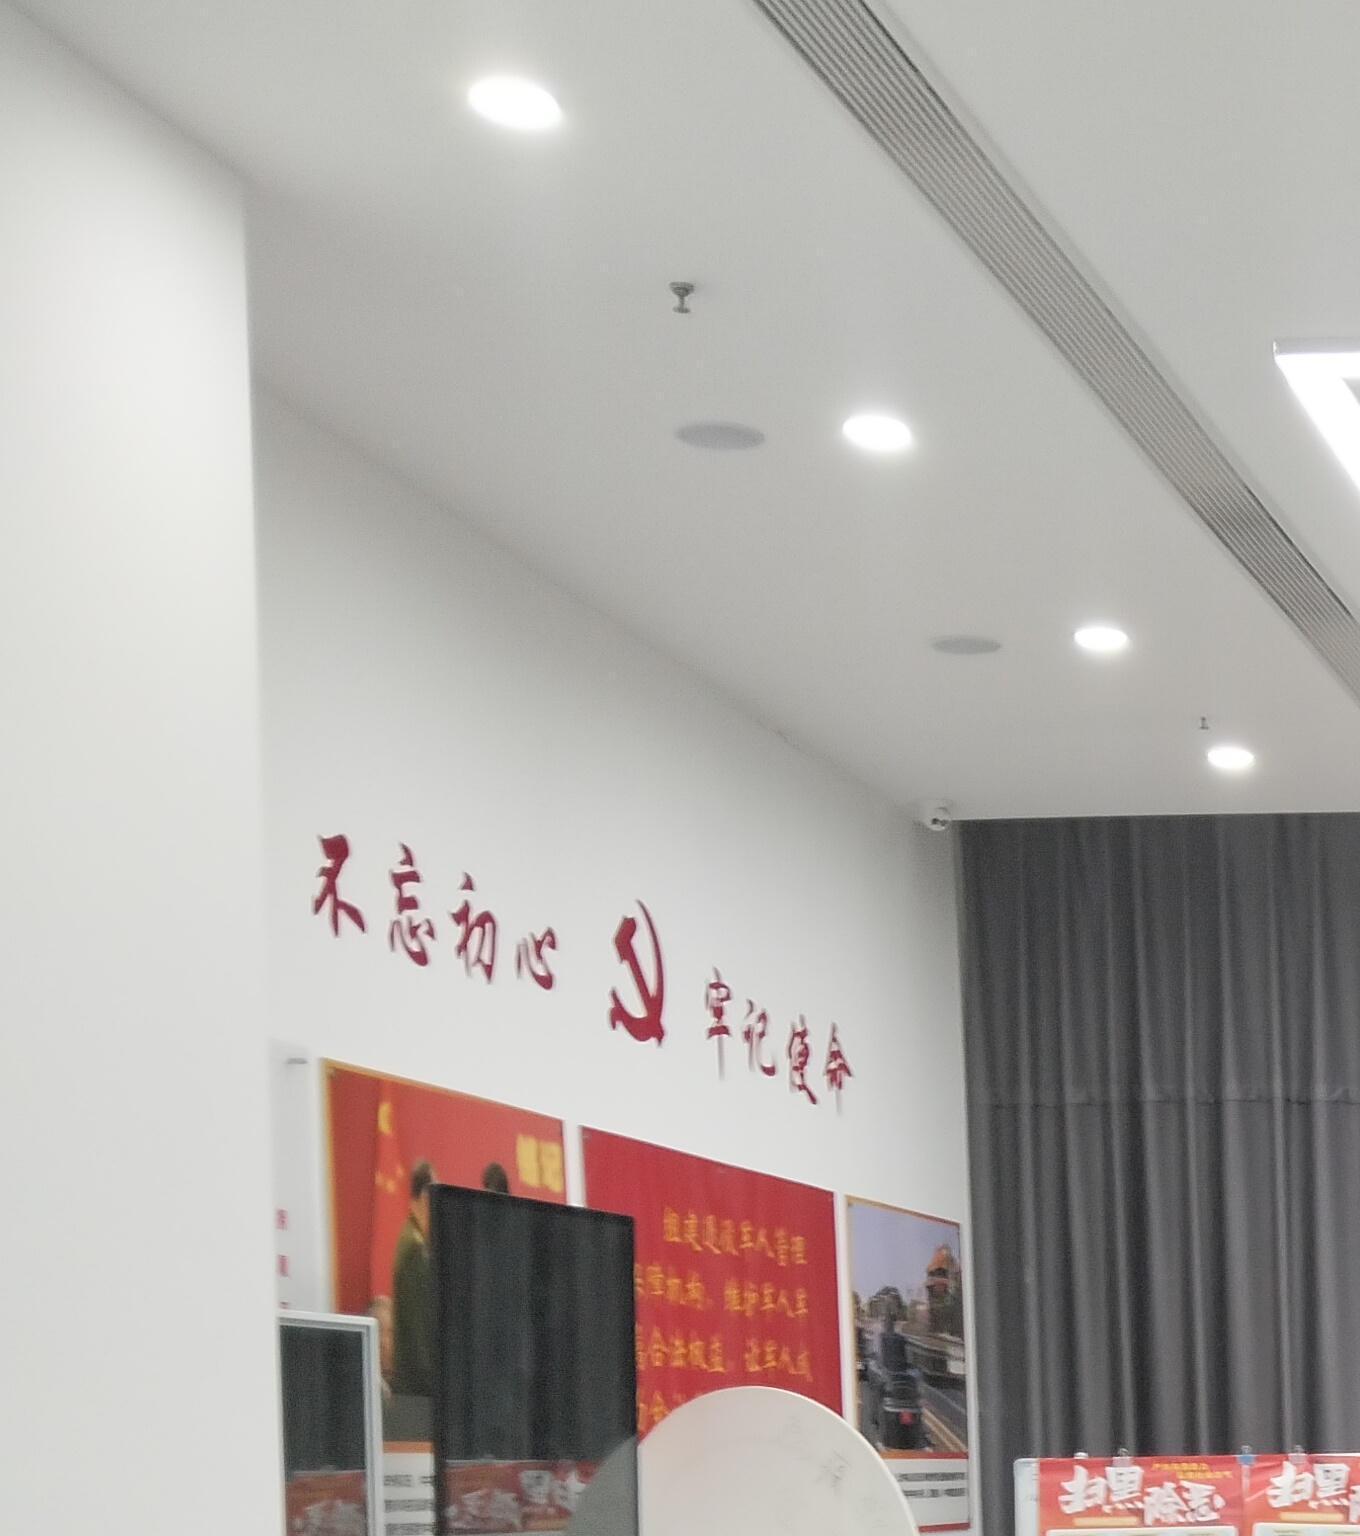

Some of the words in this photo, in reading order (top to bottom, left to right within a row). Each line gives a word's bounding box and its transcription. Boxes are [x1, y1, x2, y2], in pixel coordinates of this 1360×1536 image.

[313, 834, 557, 990] 不忘初心
[705, 966, 853, 1115] 牢记使命
[1058, 1464, 1226, 1525] 扫黑除恶
